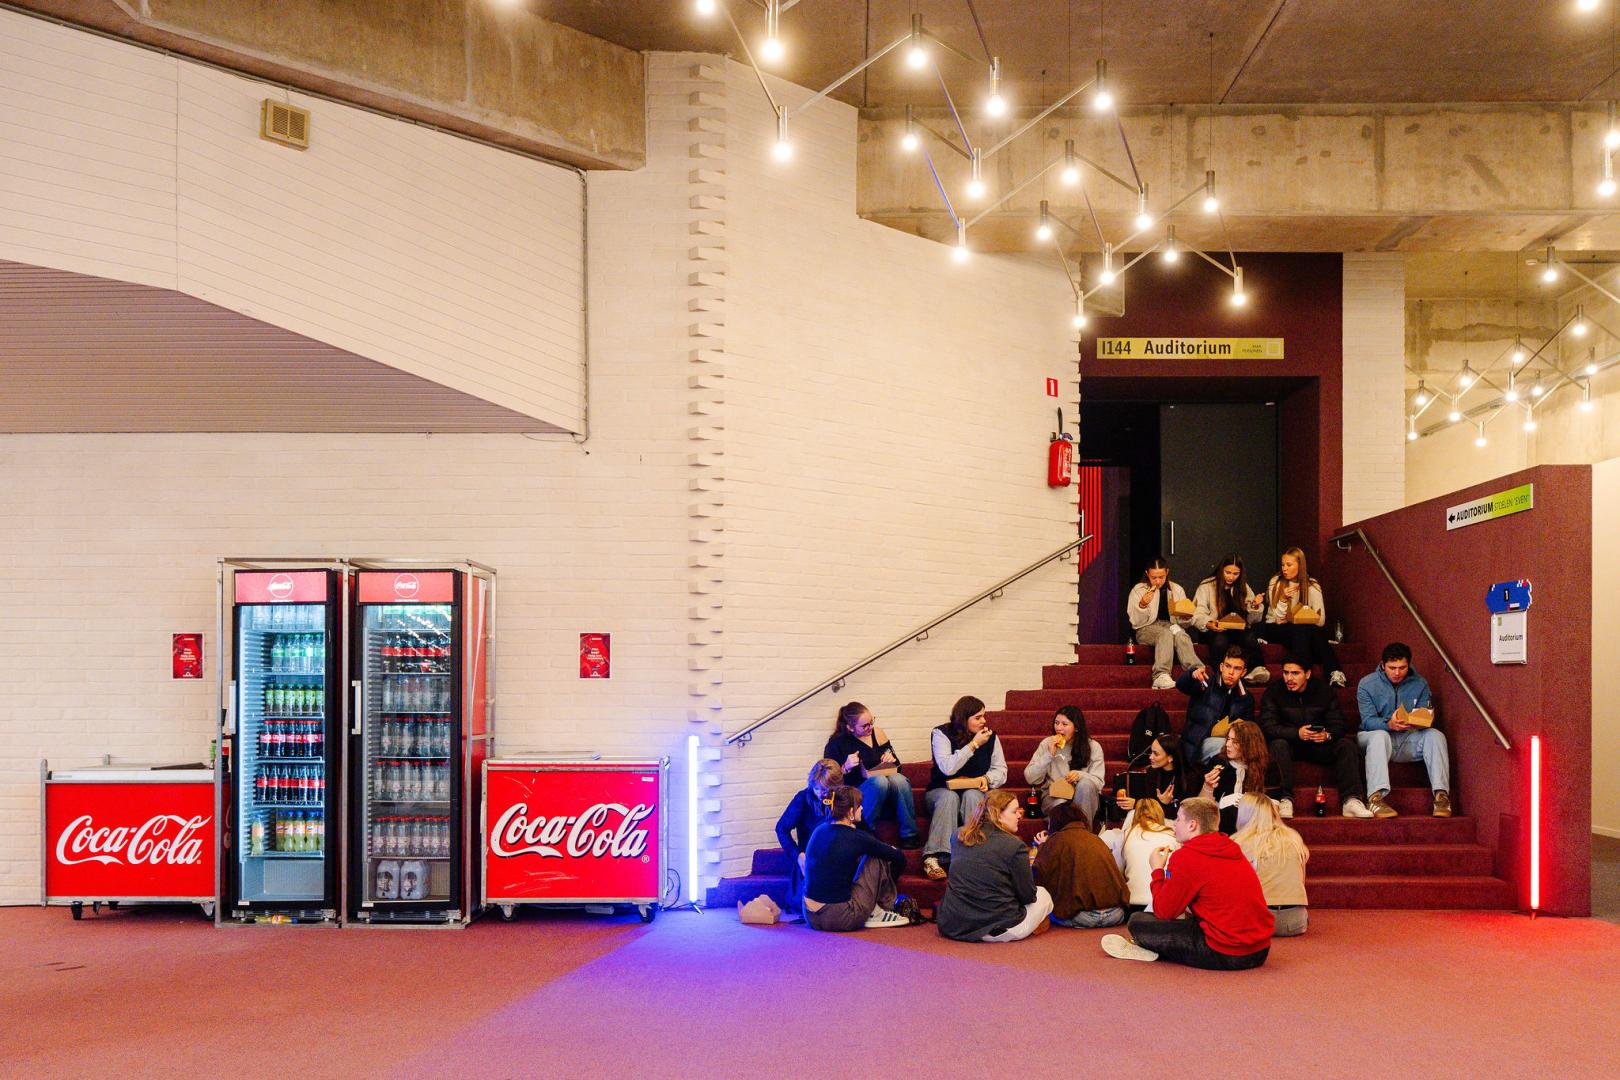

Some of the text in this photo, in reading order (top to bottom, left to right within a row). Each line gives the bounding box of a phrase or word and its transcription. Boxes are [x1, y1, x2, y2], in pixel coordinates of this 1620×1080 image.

[1144, 340, 1231, 355] Auditorium
[1456, 502, 1494, 522] AUDITORIUM
[1499, 633, 1523, 642] Auditorium
[56, 814, 212, 865] Coca-Cola
[490, 802, 656, 858] Coca-Cola
